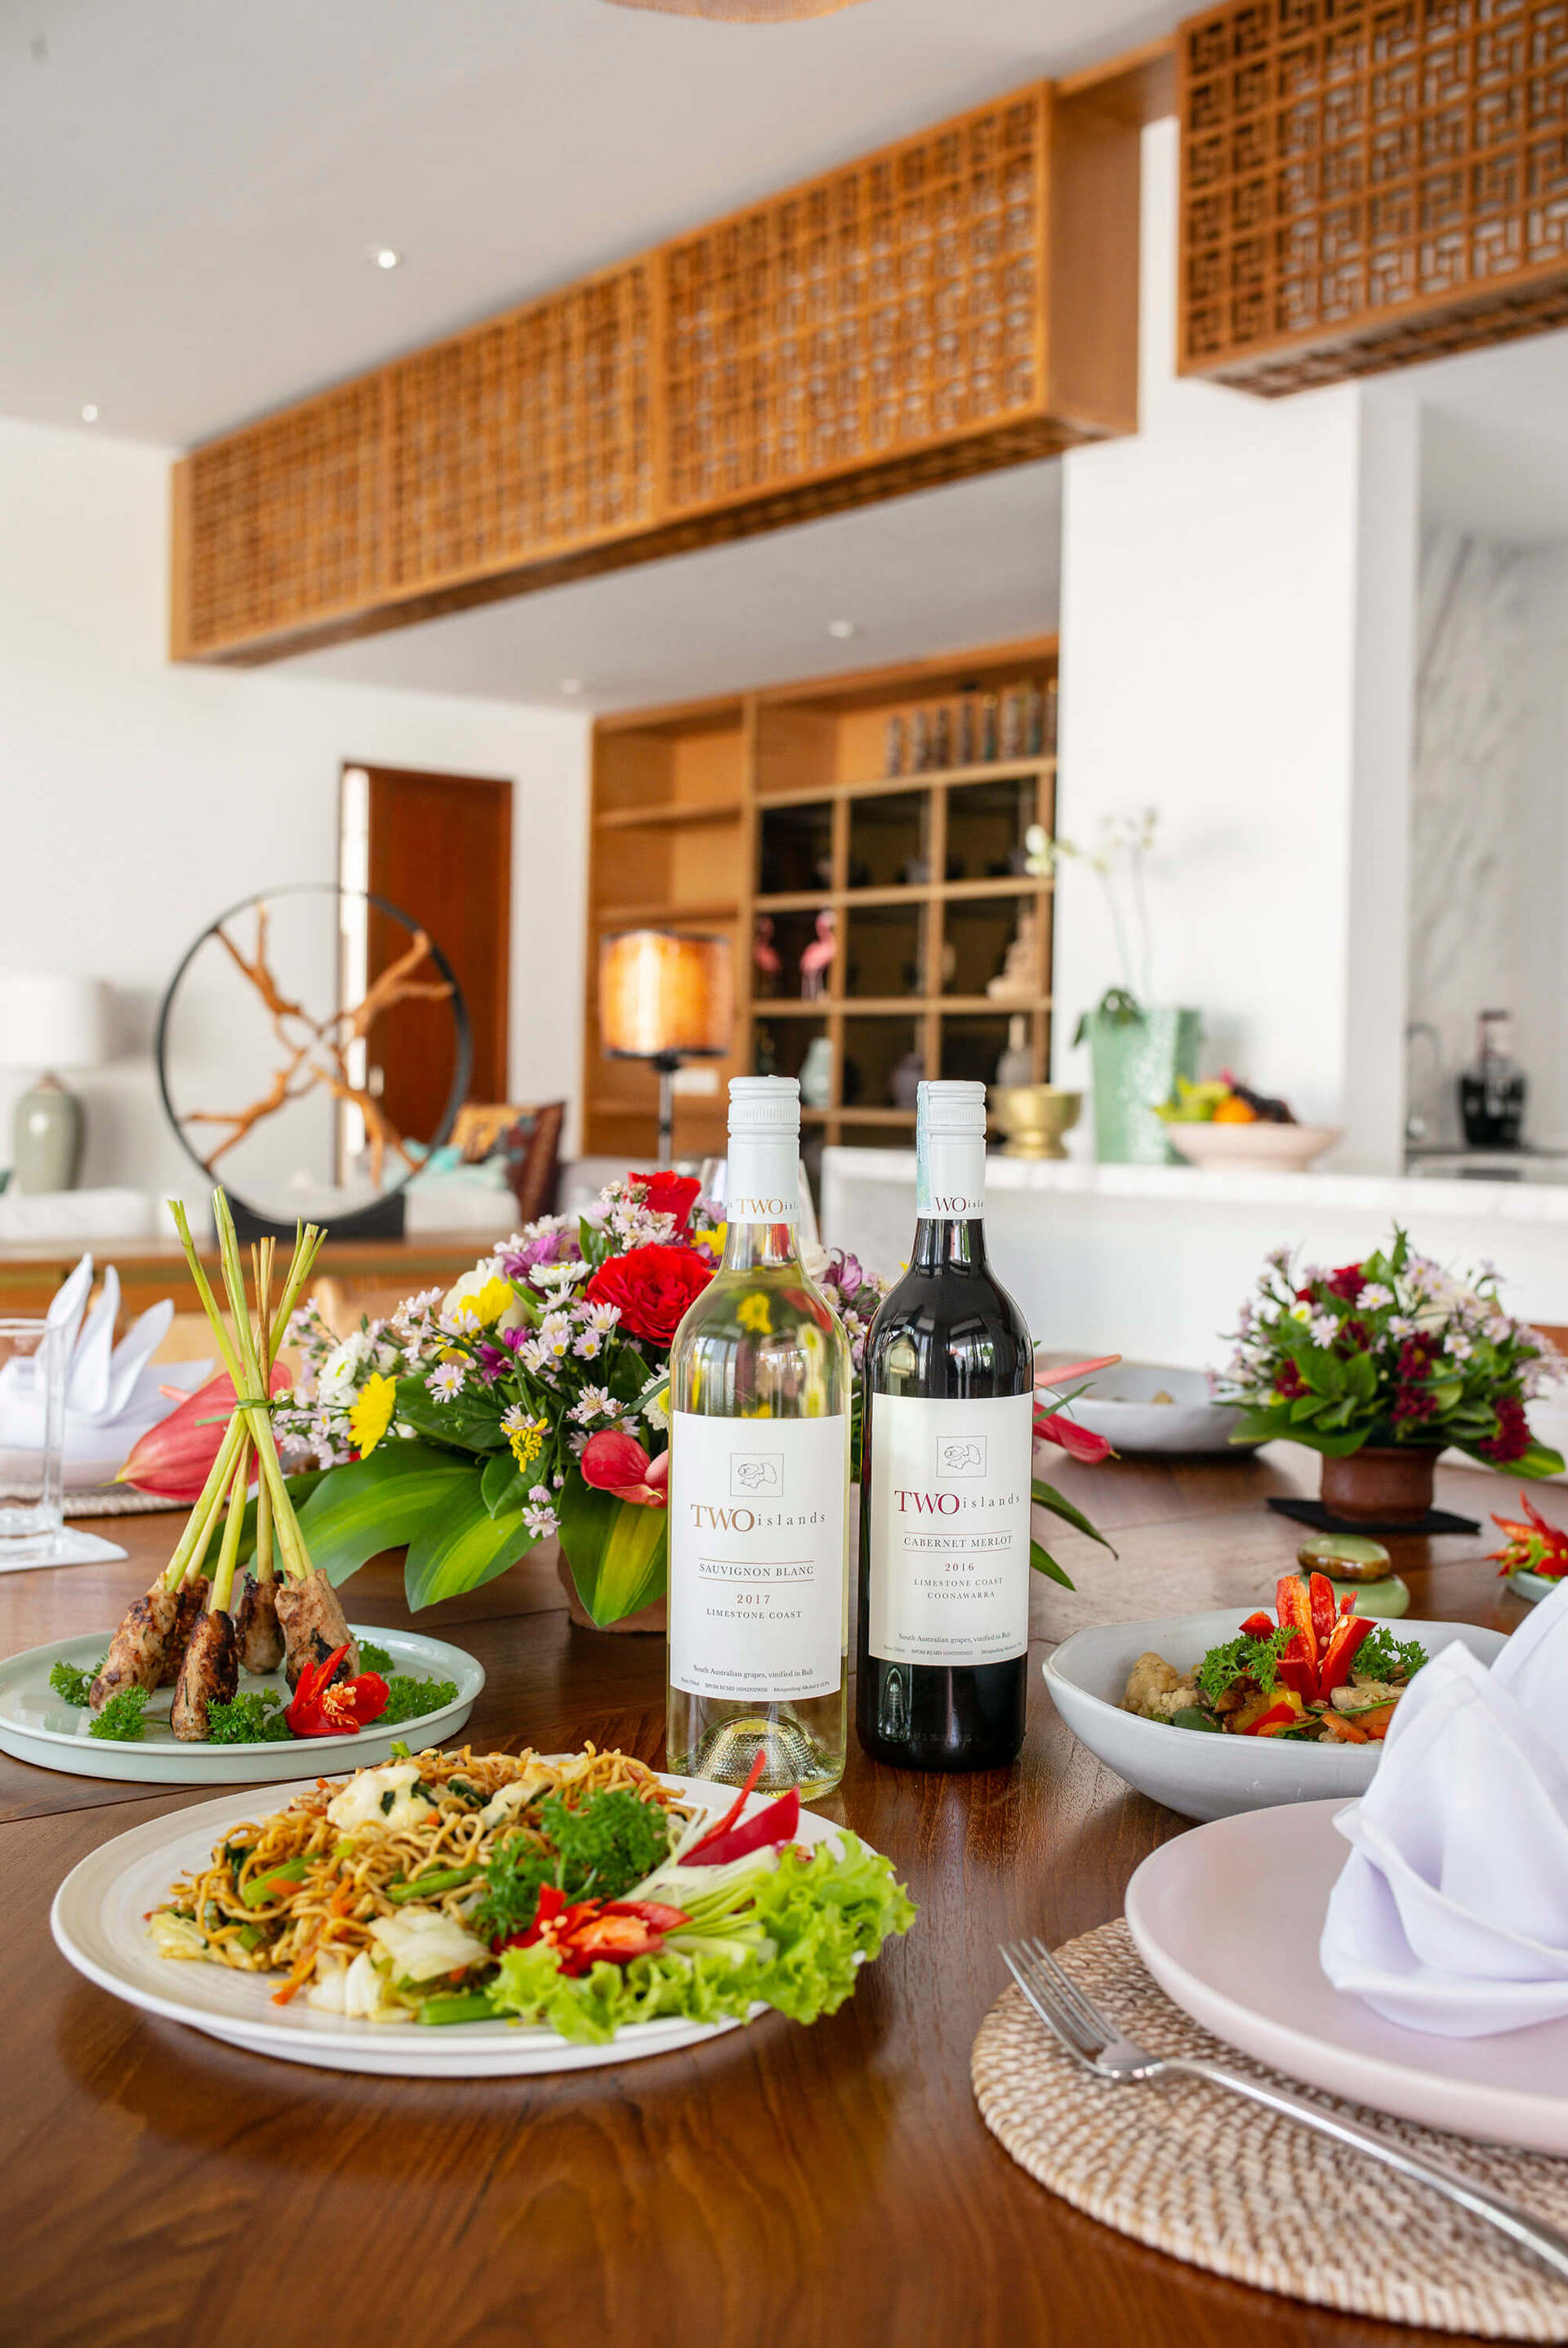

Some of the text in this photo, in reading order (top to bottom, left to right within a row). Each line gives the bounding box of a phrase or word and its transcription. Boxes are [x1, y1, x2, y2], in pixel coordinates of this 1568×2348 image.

[737, 1198, 783, 1215] TWO
[929, 1196, 967, 1212] WO
[894, 1490, 1020, 1515] TWO islands
[690, 1504, 826, 1532] TWO islands
[904, 1535, 1013, 1548] CABERNET MERLOT
[699, 1563, 813, 1577] SAUVIGNON BLANC
[945, 1563, 974, 1571] 2016
[914, 1577, 1003, 1587] LIMESTONE COAST
[737, 1594, 770, 1604] 2017
[927, 1592, 995, 1600] COONAWARRA
[706, 1608, 803, 1619] LIMESTONE COAST
[916, 1635, 949, 1643] Australian
[693, 1664, 709, 1673] South
[710, 1669, 742, 1677] Australian
[744, 1671, 767, 1679] grapes,
[768, 1669, 793, 1677] vinified
